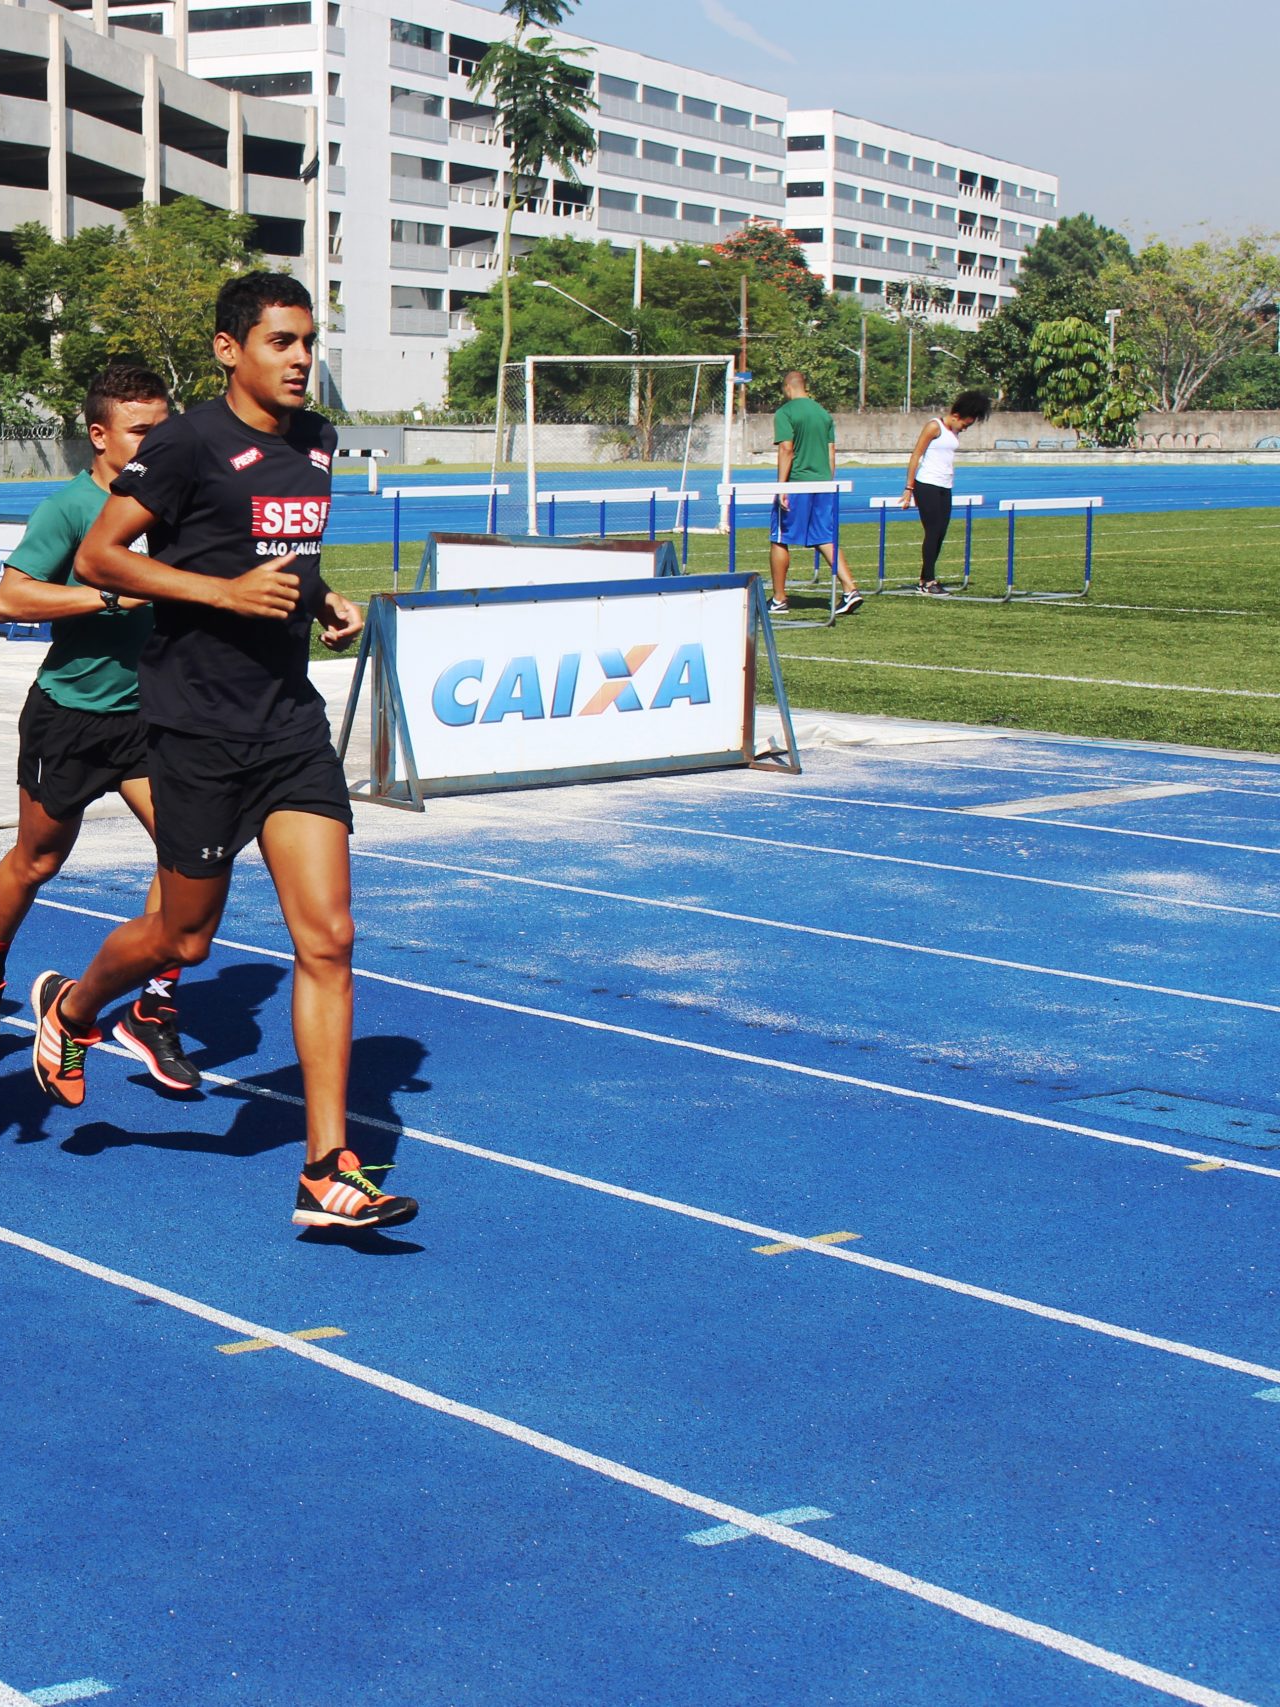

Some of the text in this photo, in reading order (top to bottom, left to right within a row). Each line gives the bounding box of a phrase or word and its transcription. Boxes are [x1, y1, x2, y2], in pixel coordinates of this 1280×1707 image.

[261, 501, 328, 534] SESI
[256, 540, 288, 556] SÃO
[431, 642, 711, 727] CAIXA
